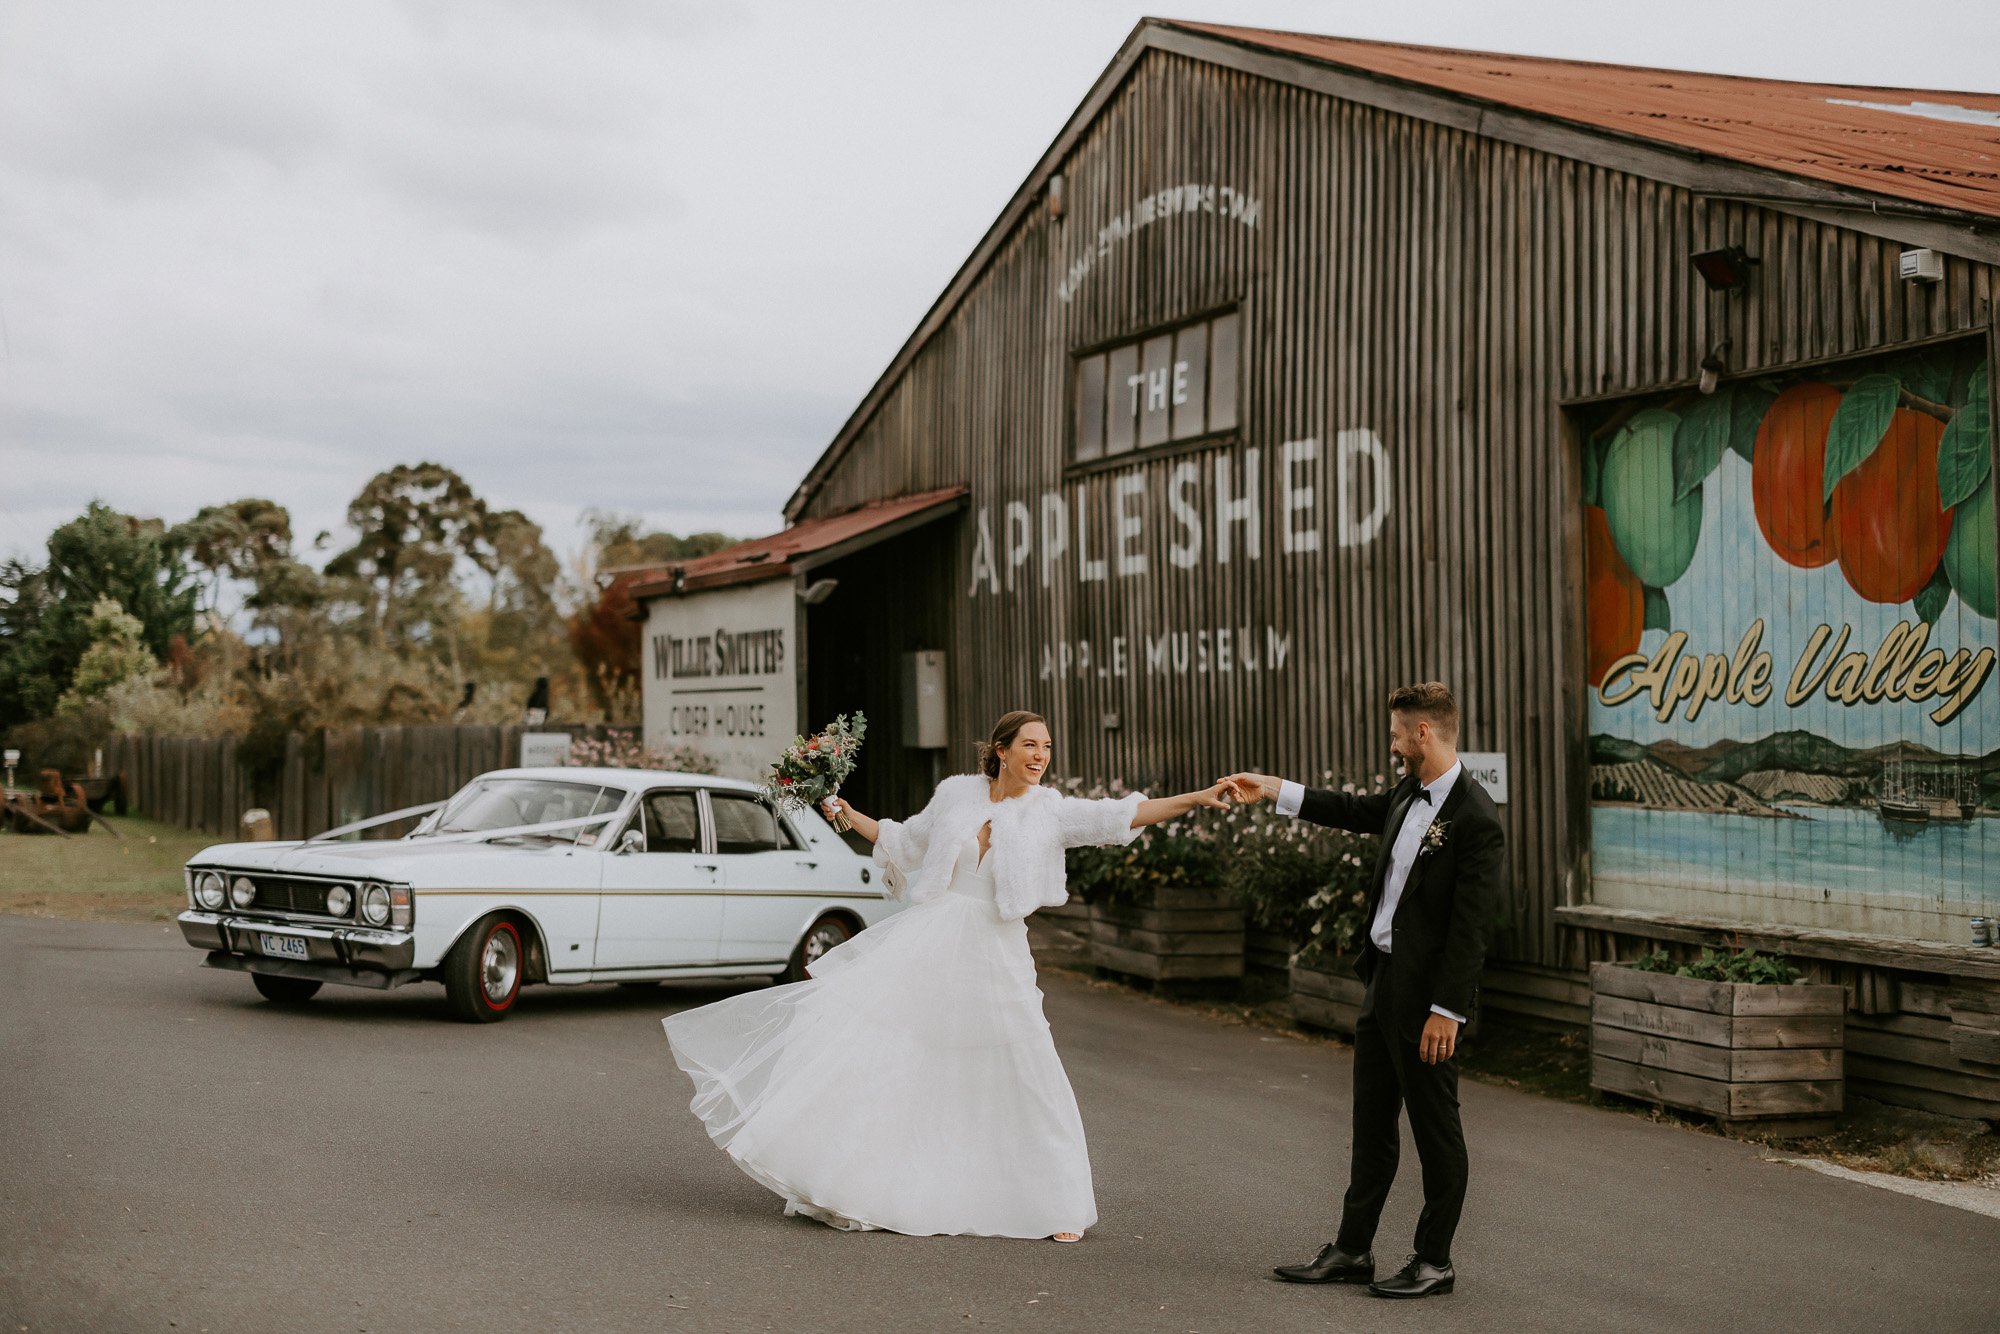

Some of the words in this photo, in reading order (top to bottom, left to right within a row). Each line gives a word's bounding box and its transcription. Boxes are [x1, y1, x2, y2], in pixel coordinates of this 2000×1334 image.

[1127, 361, 1188, 416] THE
[1599, 618, 1773, 722] Apple
[1785, 620, 1996, 727] Valley
[713, 703, 765, 737] HOUSE
